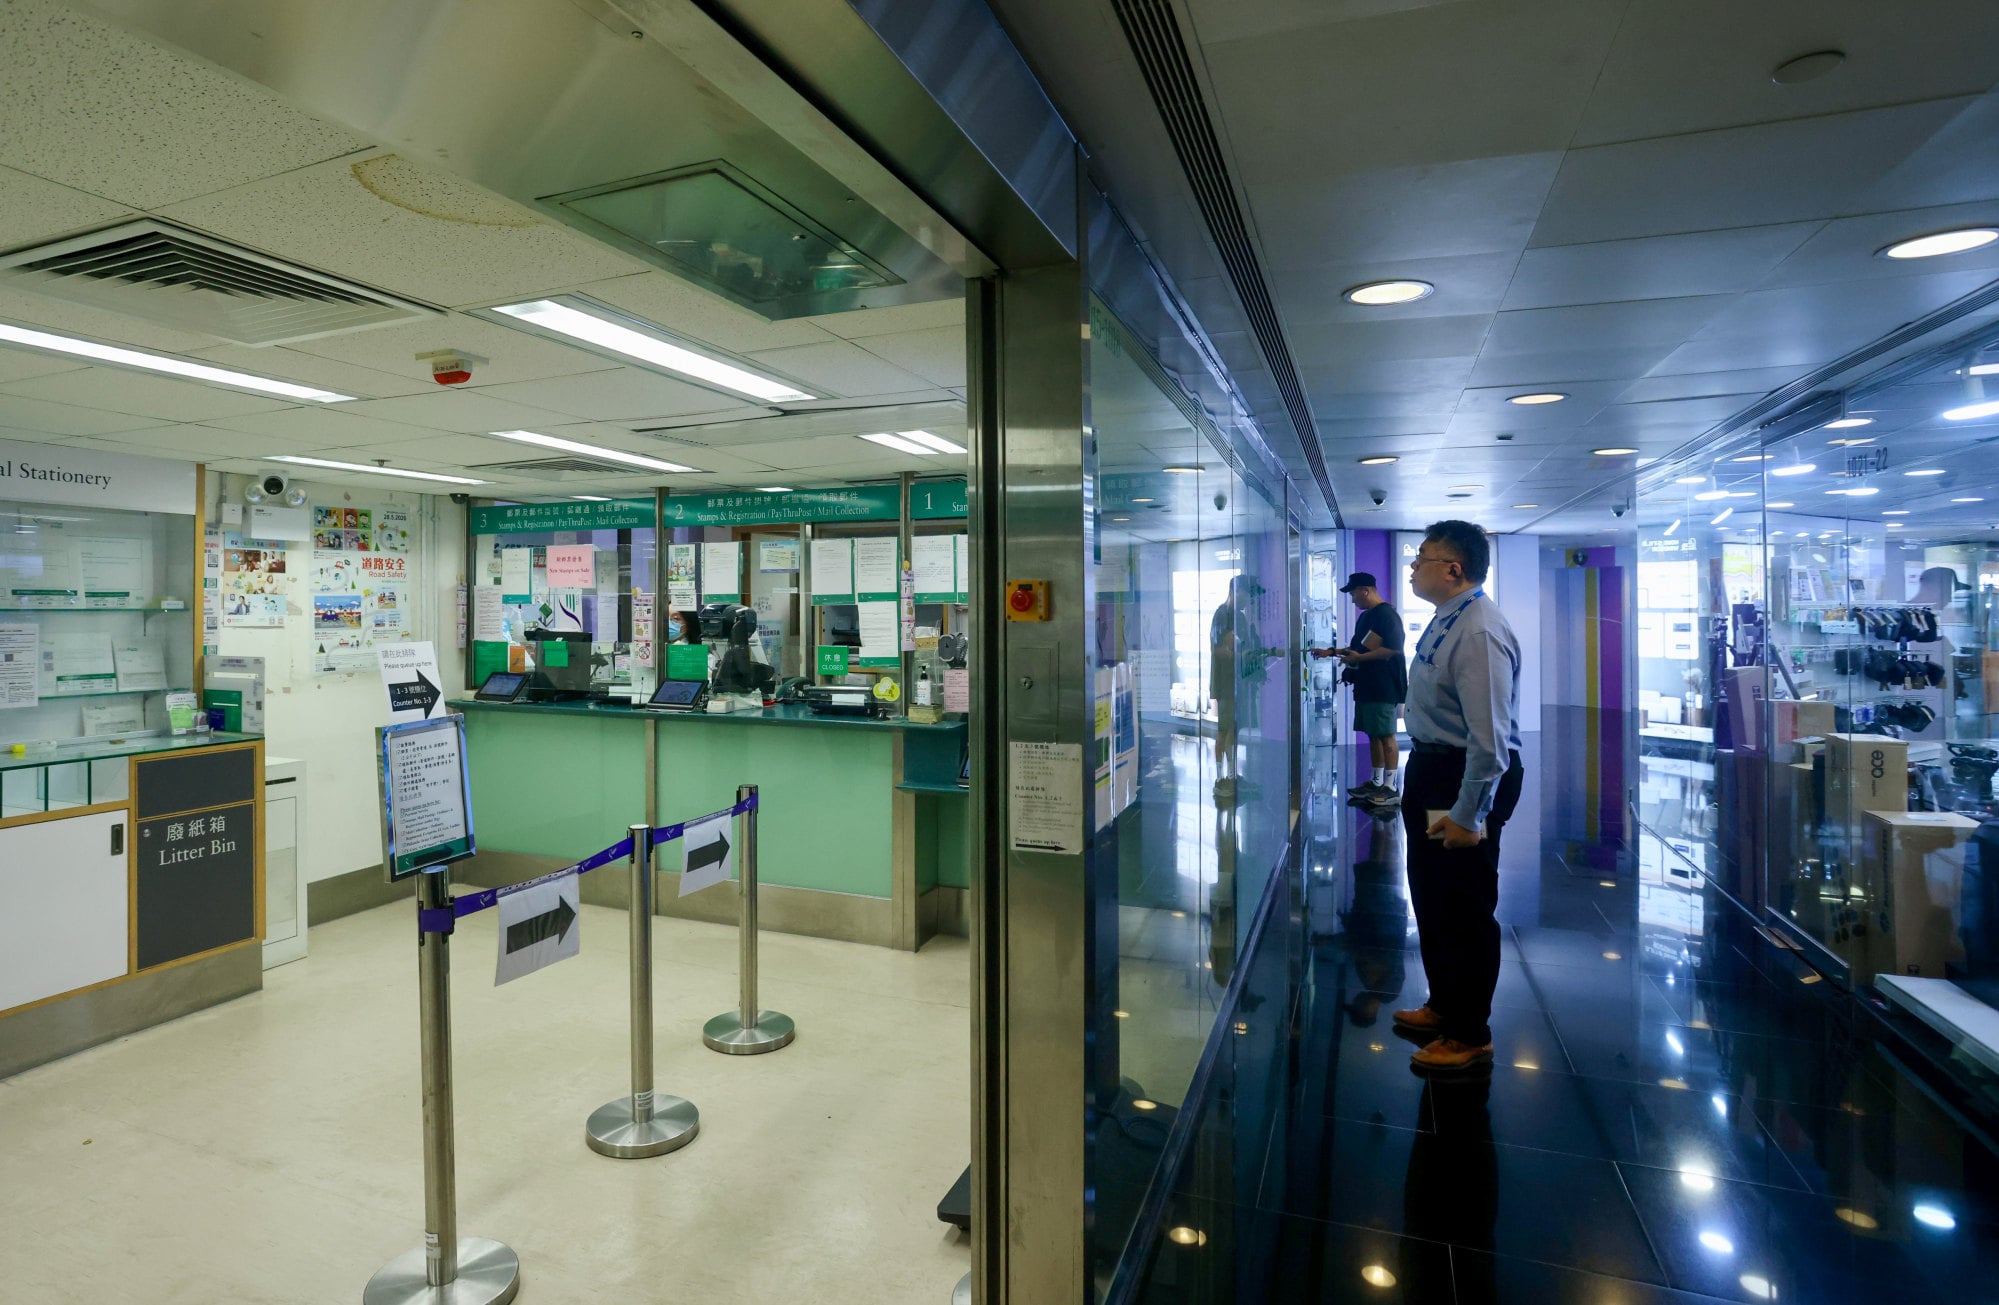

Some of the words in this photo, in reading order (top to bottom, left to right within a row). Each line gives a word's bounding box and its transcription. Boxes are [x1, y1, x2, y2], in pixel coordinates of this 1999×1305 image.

[19, 462, 112, 490] Stationery
[923, 492, 933, 510] 1
[674, 504, 684, 520] 2
[697, 512, 719, 523] Stamps
[720, 512, 727, 521] &
[728, 509, 766, 522] Registration
[817, 505, 834, 516] Mail
[835, 504, 870, 515] Collection
[480, 514, 487, 528] 3
[498, 520, 517, 531] Stamps
[517, 520, 522, 528] &
[523, 519, 555, 530] Registration
[596, 516, 609, 526] Mail
[610, 515, 638, 525] Collection
[362, 557, 405, 570] 道路安全
[387, 571, 407, 579] Safety
[824, 653, 841, 662] 休息
[393, 699, 413, 707] Counter
[1871, 749, 1884, 778] ace
[166, 815, 226, 842] 廢紙箱
[159, 846, 205, 866] Litter
[210, 838, 237, 856] Bin
